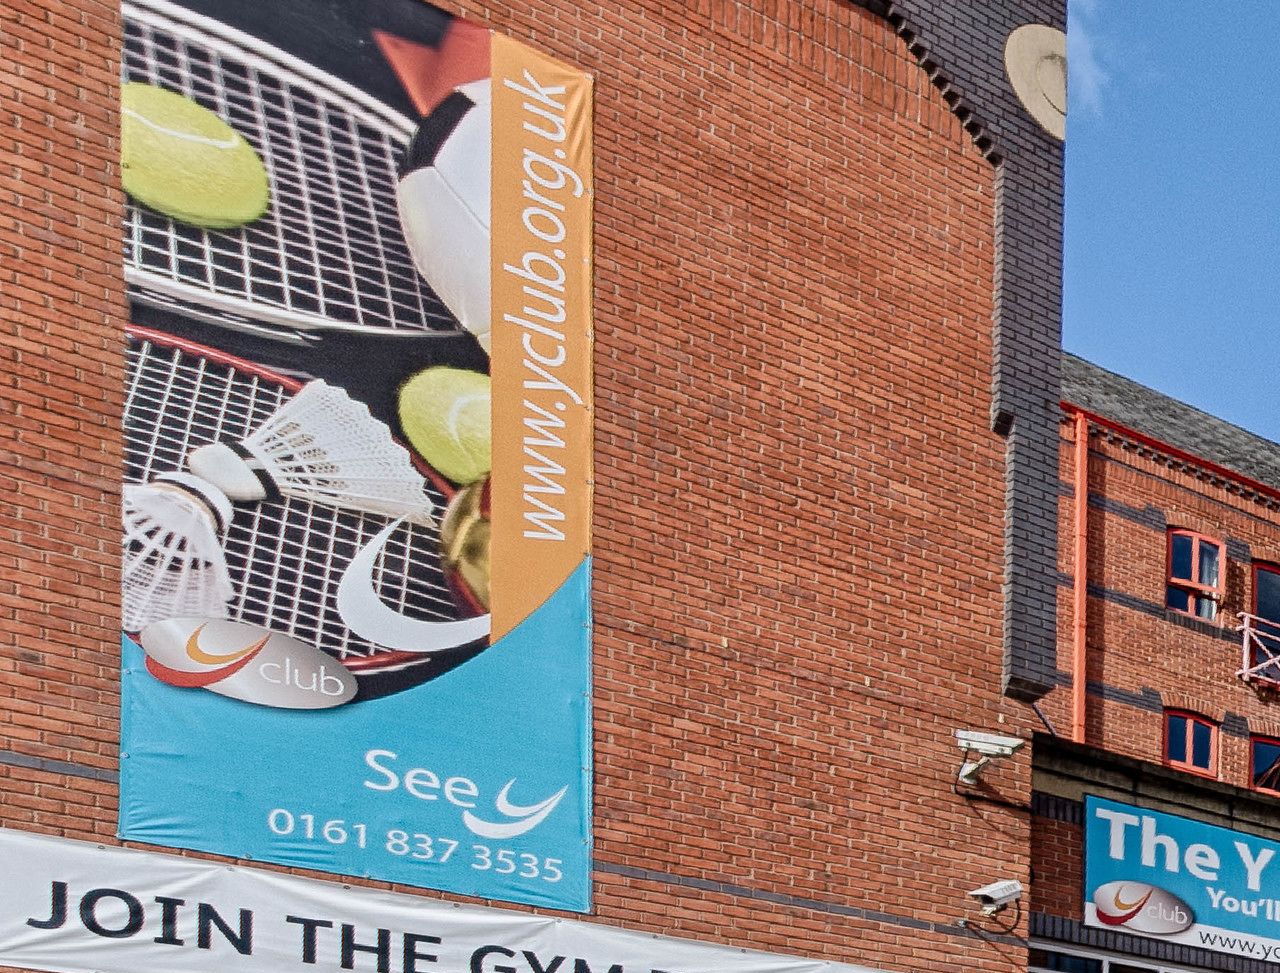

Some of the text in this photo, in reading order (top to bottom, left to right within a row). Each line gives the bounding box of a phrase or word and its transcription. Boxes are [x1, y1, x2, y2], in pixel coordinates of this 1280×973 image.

[503, 66, 584, 542] www.yclub.org.uk
[259, 658, 345, 697] club
[363, 748, 480, 808] See
[267, 808, 564, 882] 0161 837 3535
[1096, 807, 1221, 881] The
[1234, 841, 1276, 892] Y
[25, 880, 255, 956] JOIN
[1147, 903, 1188, 925] club
